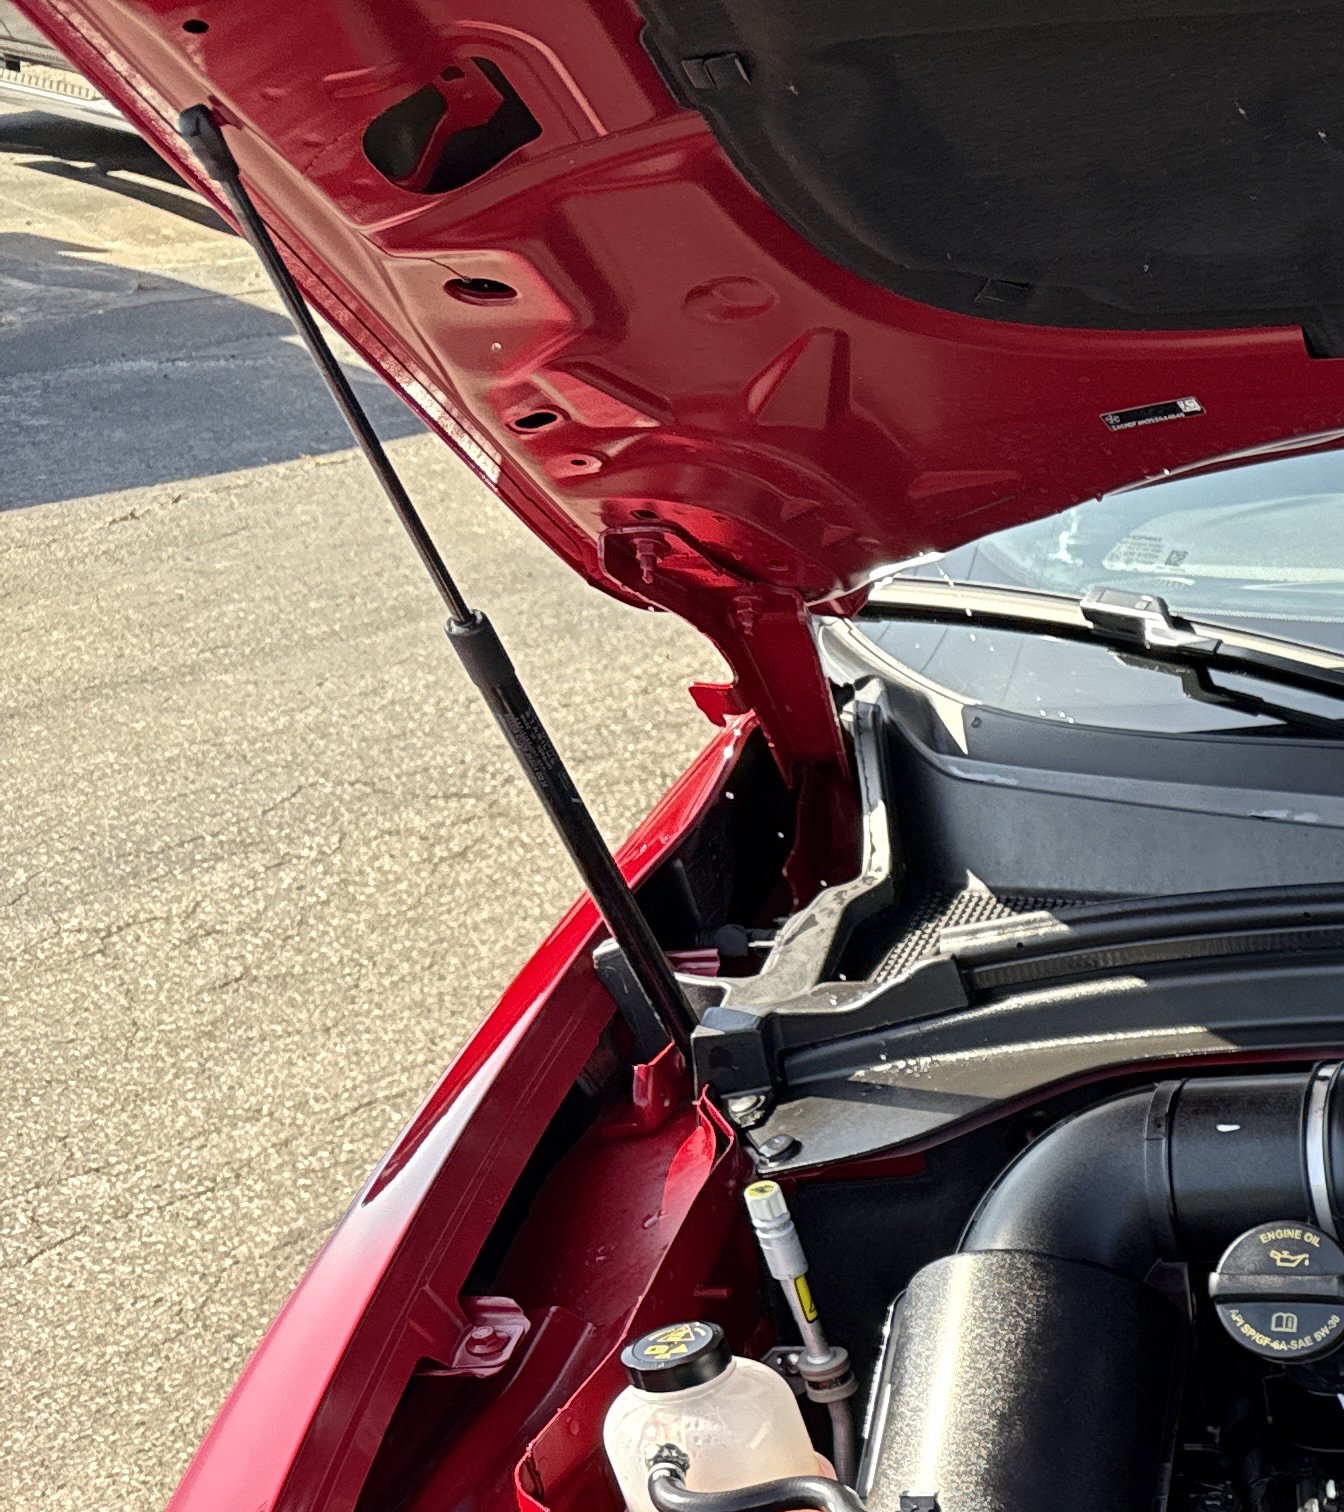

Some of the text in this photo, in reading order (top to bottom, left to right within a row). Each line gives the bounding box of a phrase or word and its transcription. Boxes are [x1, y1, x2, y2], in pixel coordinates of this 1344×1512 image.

[1260, 1229, 1320, 1248] ENGINE OIL
[1229, 1309, 1244, 1327] API
[1314, 1314, 1340, 1342] 5W-30
